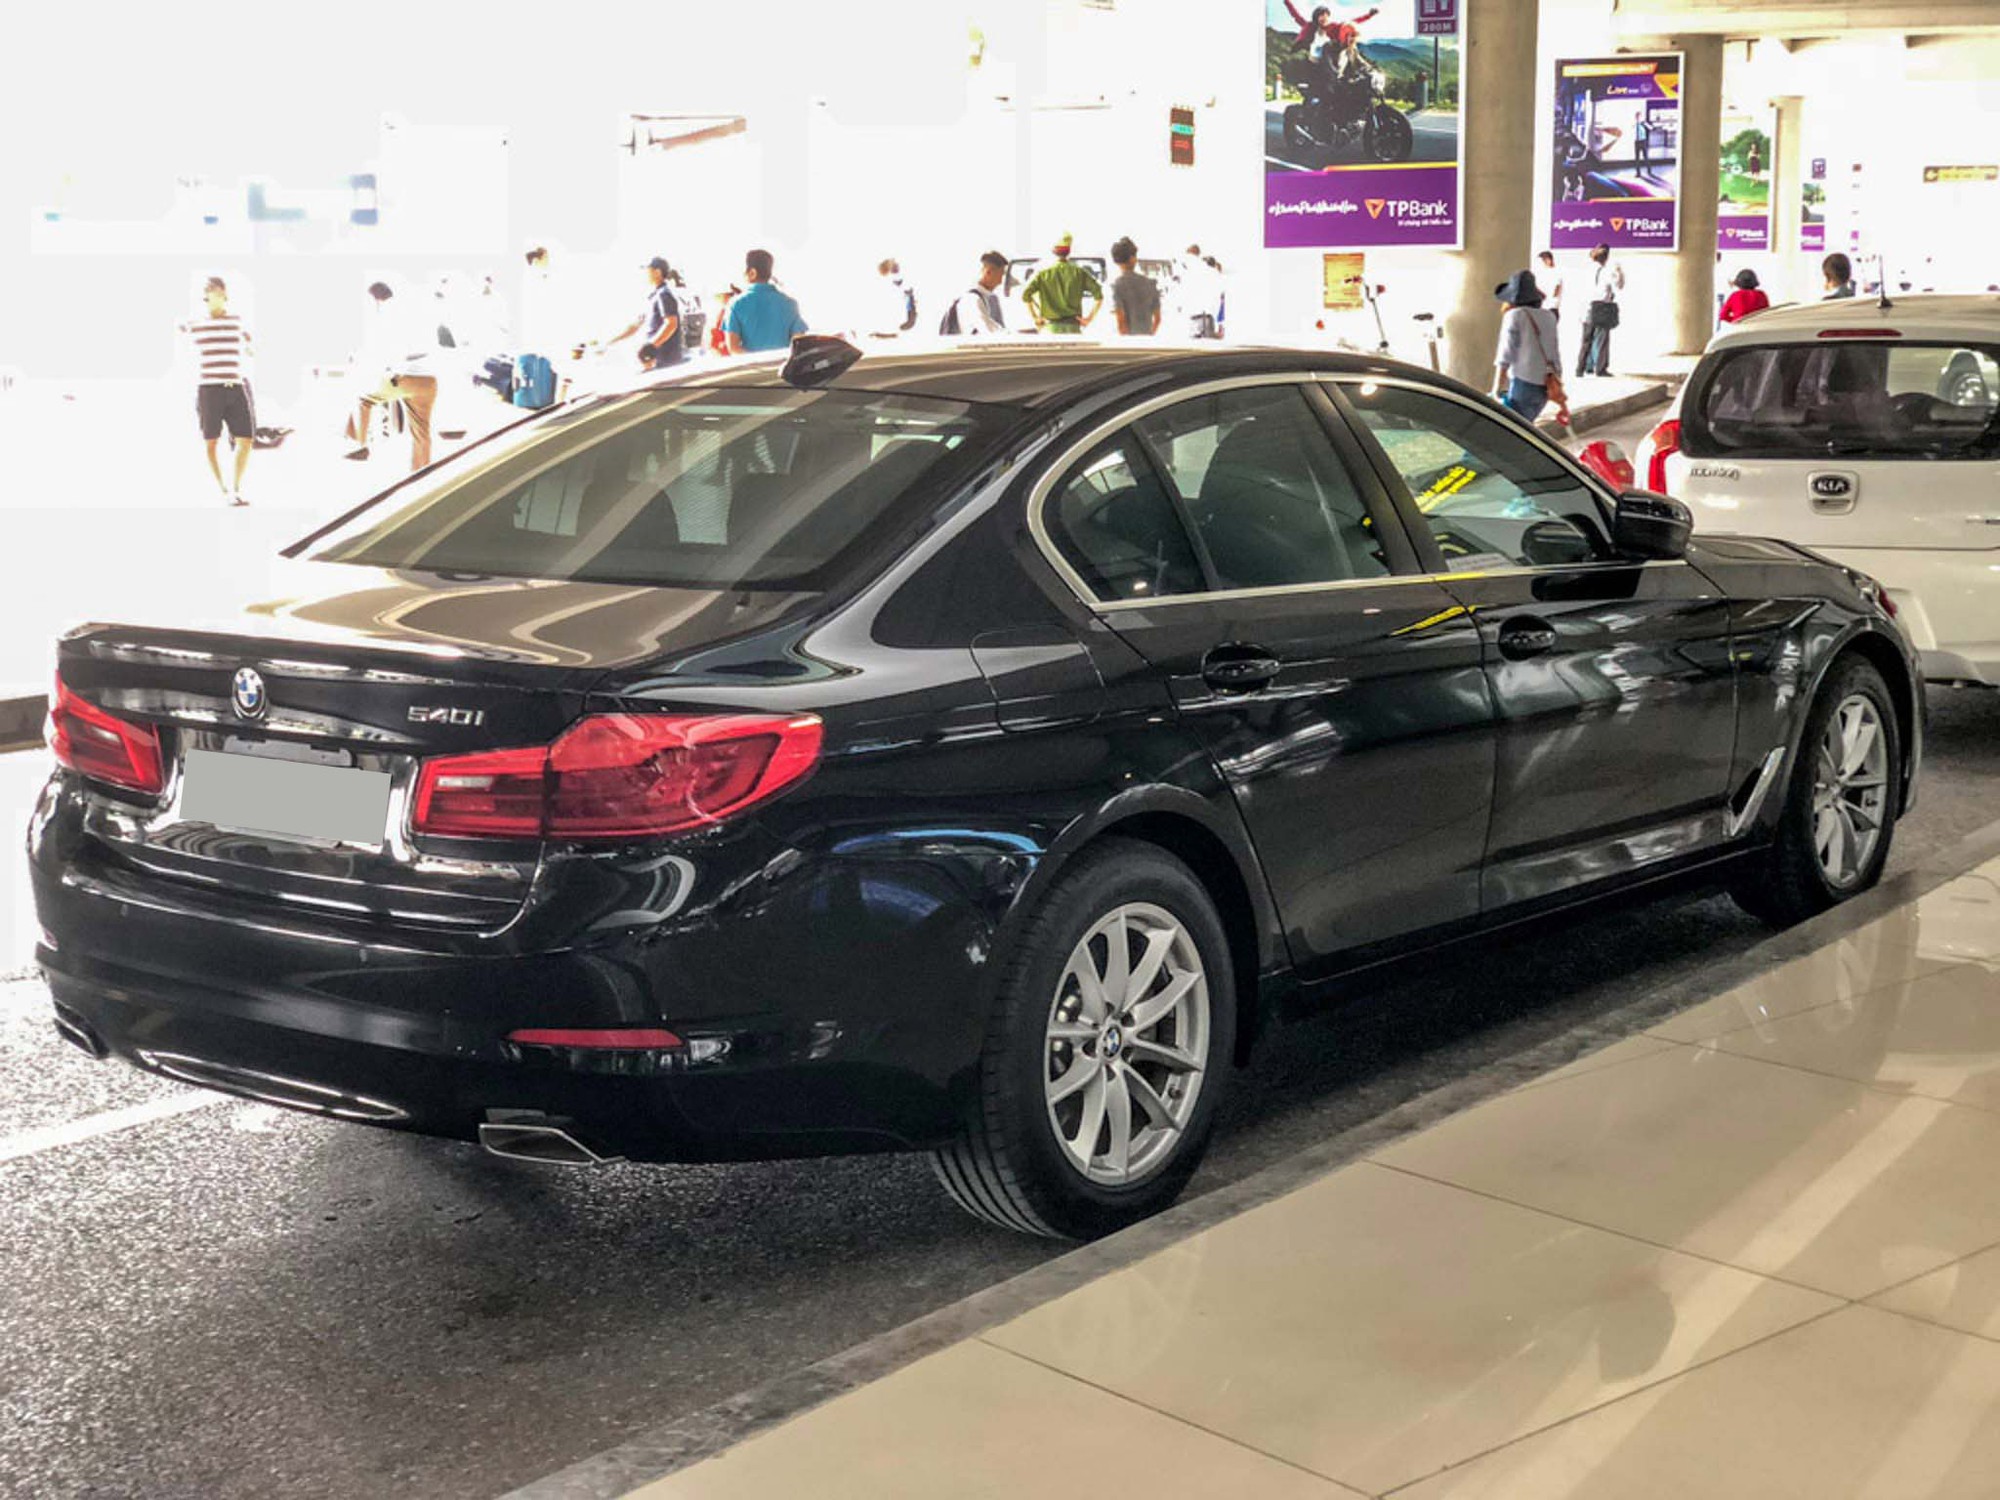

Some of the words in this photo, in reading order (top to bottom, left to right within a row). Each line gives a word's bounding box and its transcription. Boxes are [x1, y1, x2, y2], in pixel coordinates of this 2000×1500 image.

[1386, 199, 1448, 218] TPBank
[1625, 218, 1669, 231] TPBank
[1816, 480, 1847, 492] KIA
